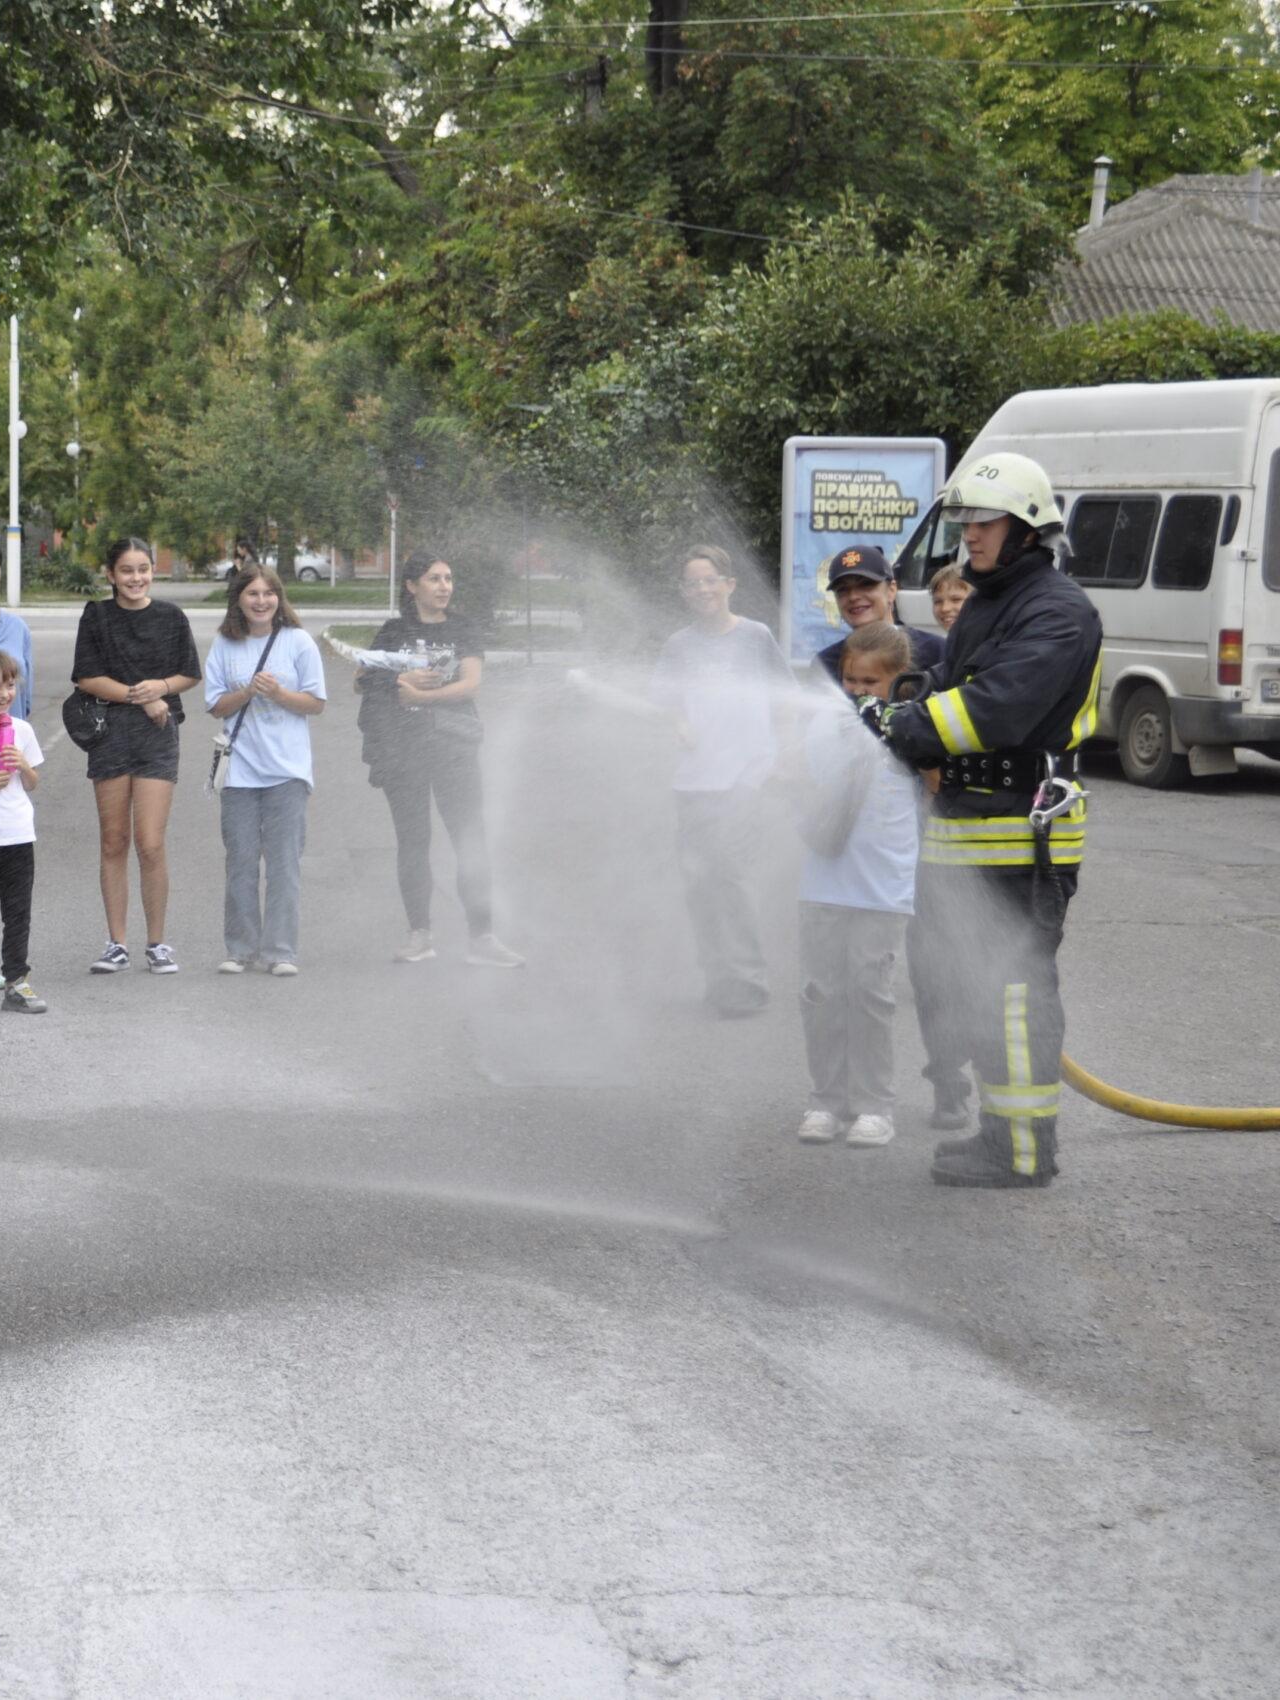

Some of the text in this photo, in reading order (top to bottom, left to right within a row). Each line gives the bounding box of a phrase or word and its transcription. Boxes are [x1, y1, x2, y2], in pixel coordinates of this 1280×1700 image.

[815, 472, 882, 483] ПОЯСНИ ДІТЯМ
[976, 465, 999, 480] 20
[814, 482, 898, 498] ПРАВИЛА
[828, 515, 901, 532] ВОГНЕМ
